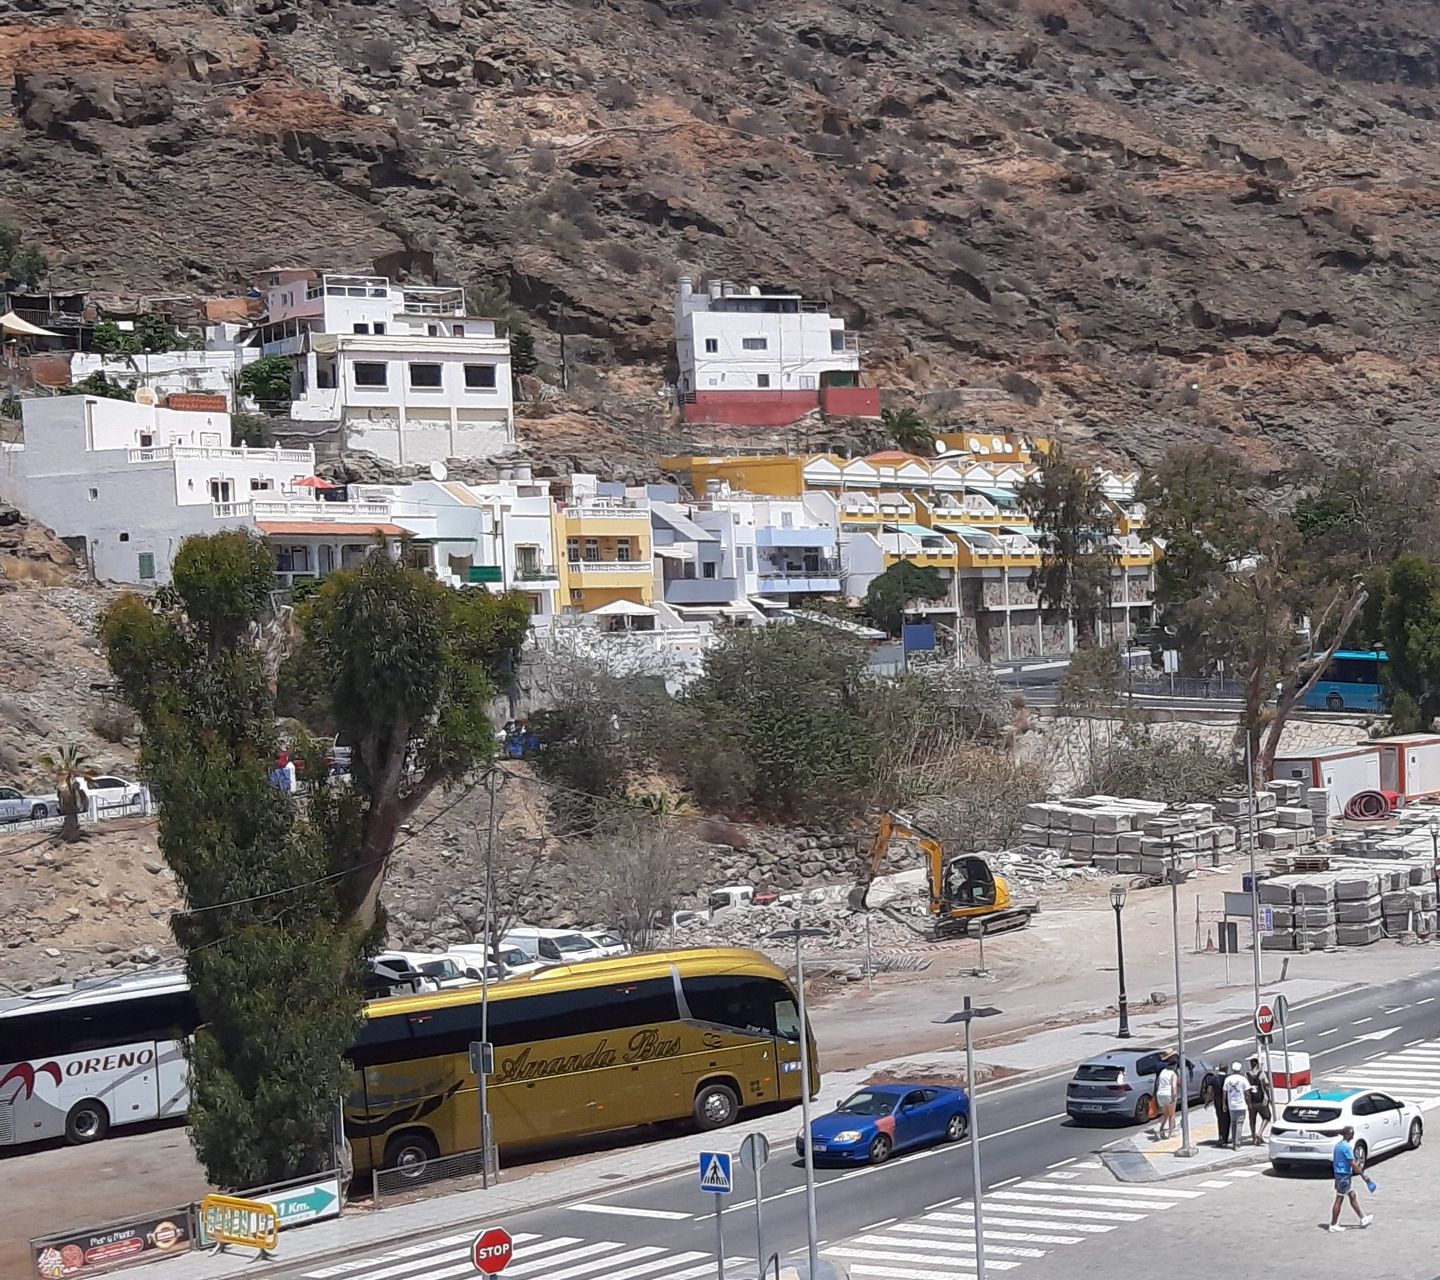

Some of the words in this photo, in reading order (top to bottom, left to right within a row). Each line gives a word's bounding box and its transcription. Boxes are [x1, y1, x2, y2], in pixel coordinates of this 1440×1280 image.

[1258, 1014, 1273, 1025] STOP
[496, 1038, 616, 1083] Amanda
[623, 1028, 681, 1063] Bus
[479, 1243, 510, 1259] STOP
